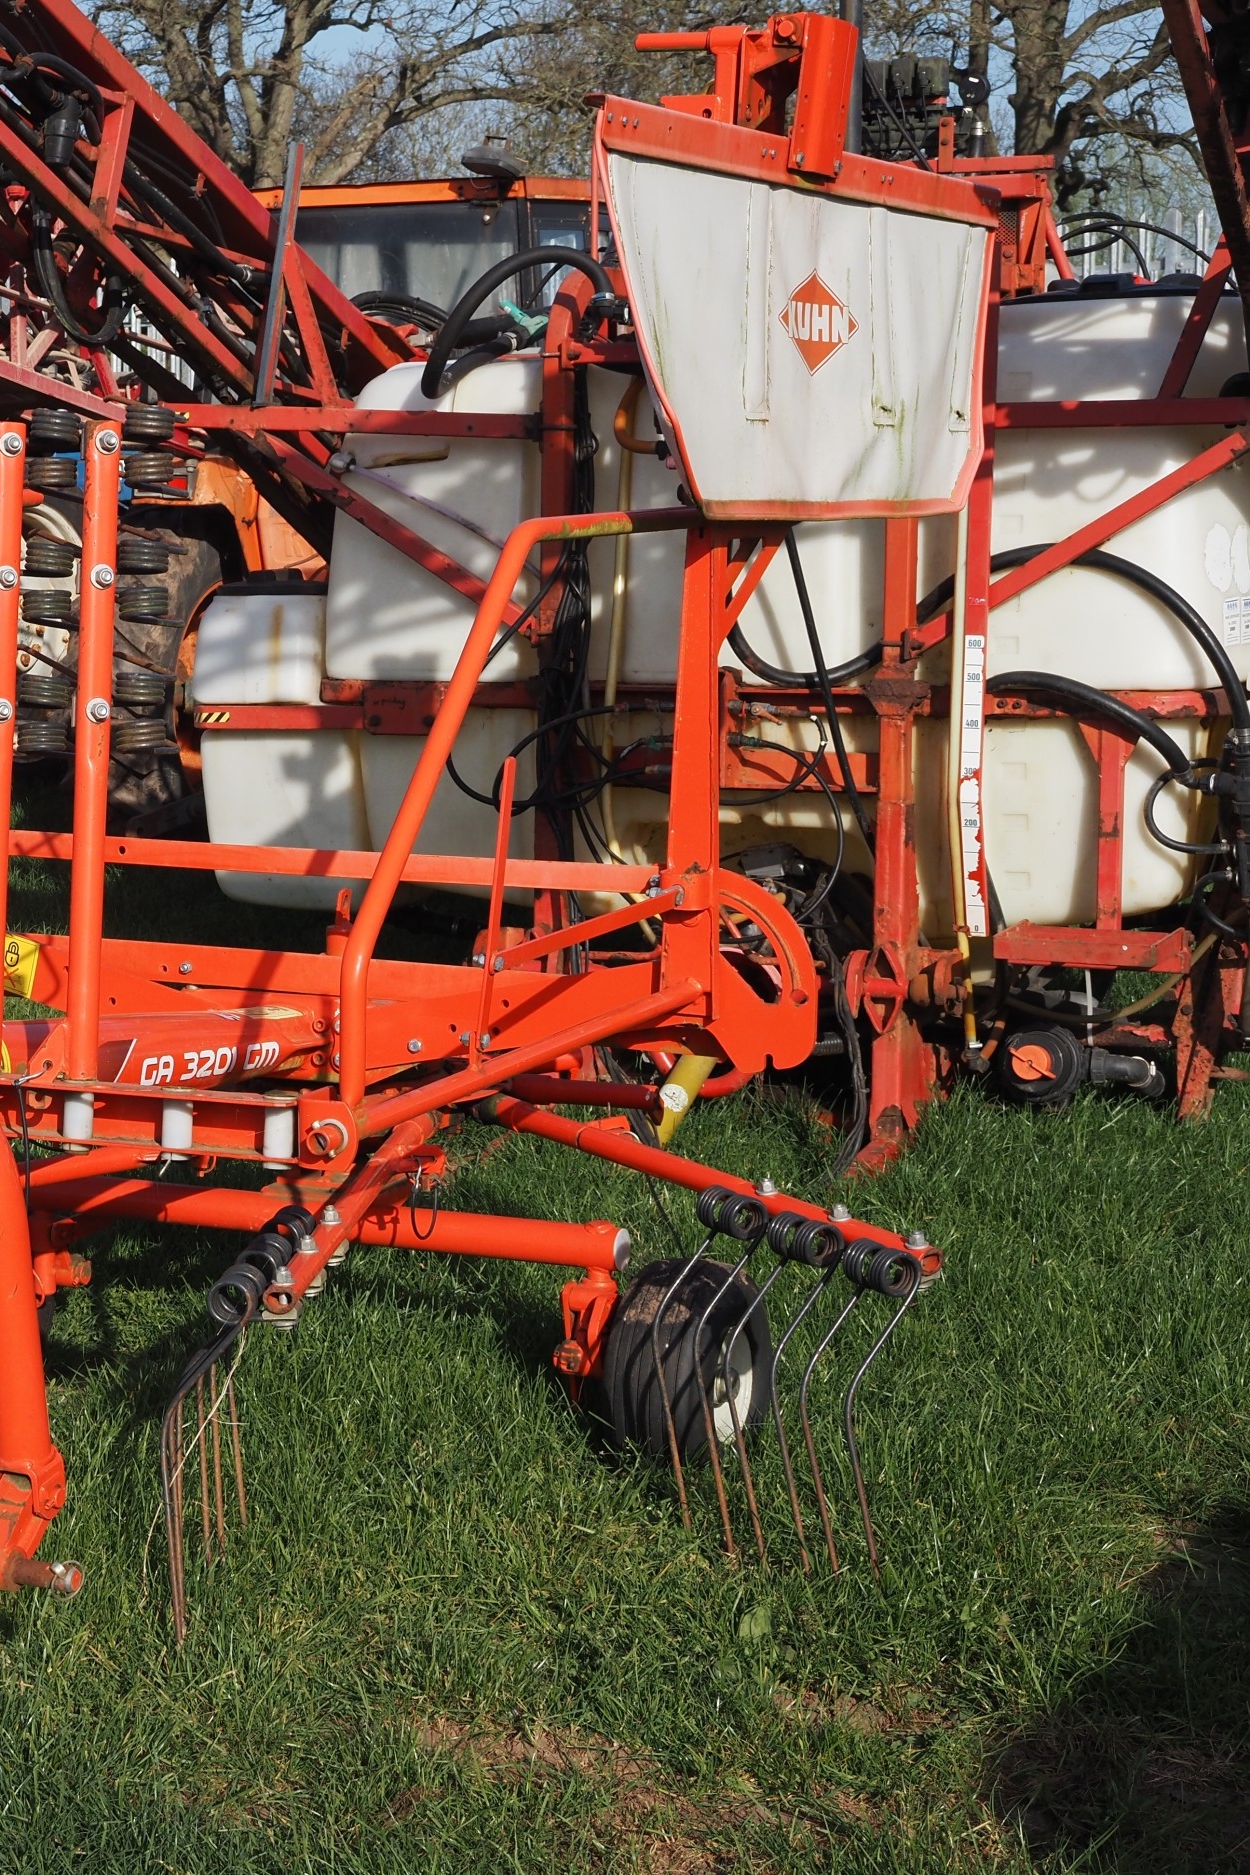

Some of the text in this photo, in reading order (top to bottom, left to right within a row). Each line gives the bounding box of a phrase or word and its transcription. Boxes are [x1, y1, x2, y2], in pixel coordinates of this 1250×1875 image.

[788, 300, 849, 344] KUHN
[968, 639, 982, 648] 600
[967, 672, 981, 681] 500
[965, 719, 979, 728] 400
[964, 819, 978, 827] 200
[140, 1041, 280, 1086] GA 3201 GM
